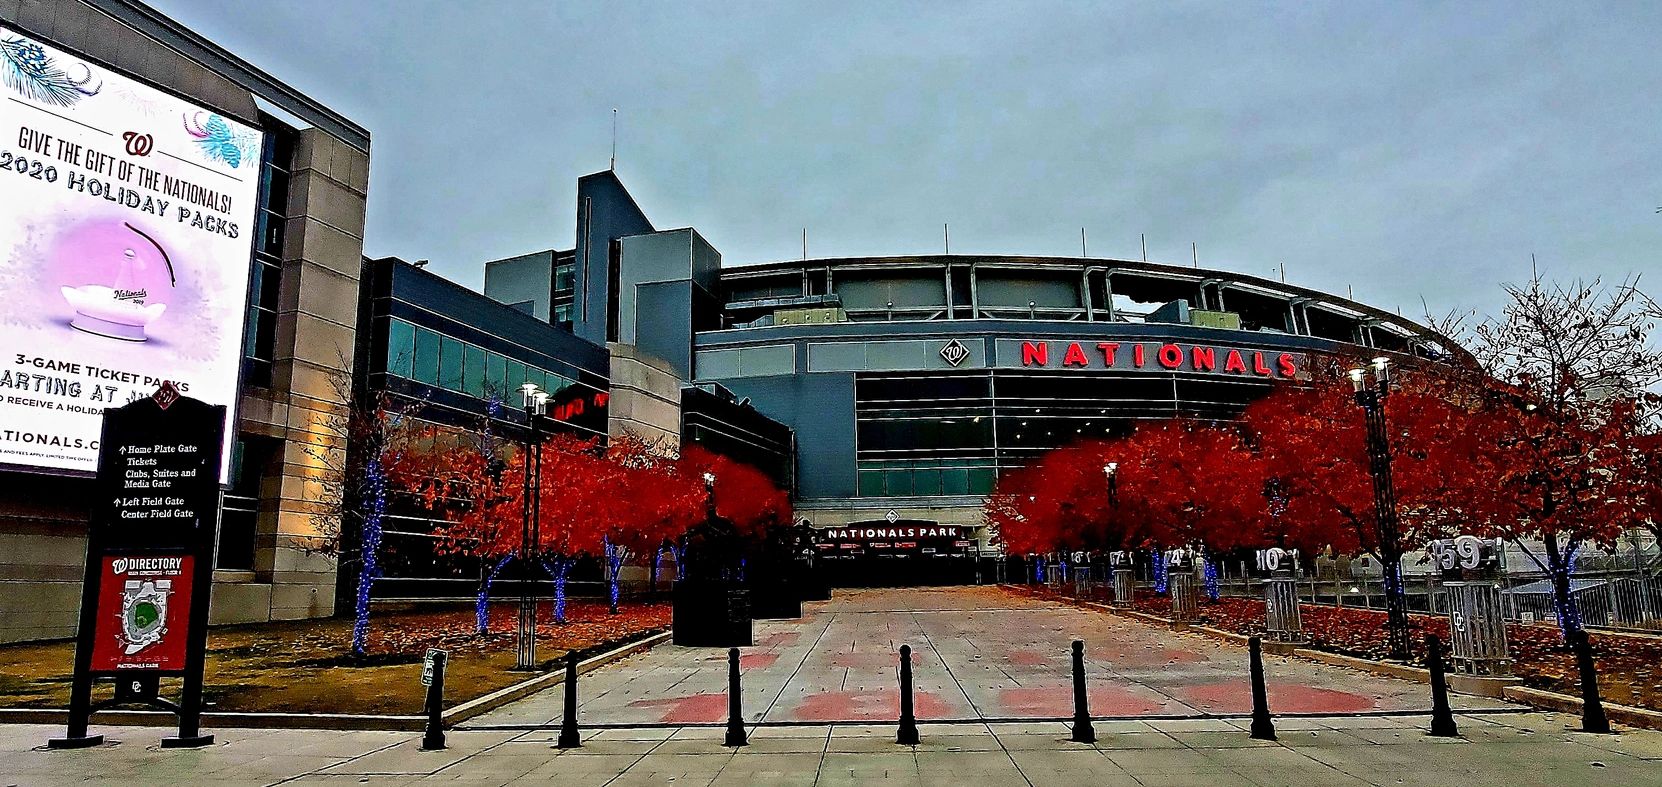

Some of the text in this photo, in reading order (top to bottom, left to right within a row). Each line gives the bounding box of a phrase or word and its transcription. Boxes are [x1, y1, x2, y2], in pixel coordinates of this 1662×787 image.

[18, 126, 232, 215] GIVE THE GIFT OF THE NATIONALS!
[0, 151, 239, 239] 2020 HOLIDAY PACKS
[1022, 340, 1296, 377] NATIONALS
[15, 353, 189, 392] 3-GAME TICKET PAKS
[90, 384, 118, 403] AT
[7, 396, 54, 409] RECEIVE
[56, 403, 64, 411] A
[0, 430, 99, 450] TIONALS.C
[127, 444, 198, 454] Home Plate Gate
[127, 457, 157, 466] Tickets
[125, 468, 196, 479] Clubs, Suites and
[124, 479, 171, 488] Media Gate
[122, 496, 185, 506] Left Field Gate
[121, 508, 194, 519] Center Field Gate
[828, 527, 957, 539] NATIONALS PARK
[1435, 535, 1481, 569] 59
[129, 557, 182, 570] DIRECTORY
